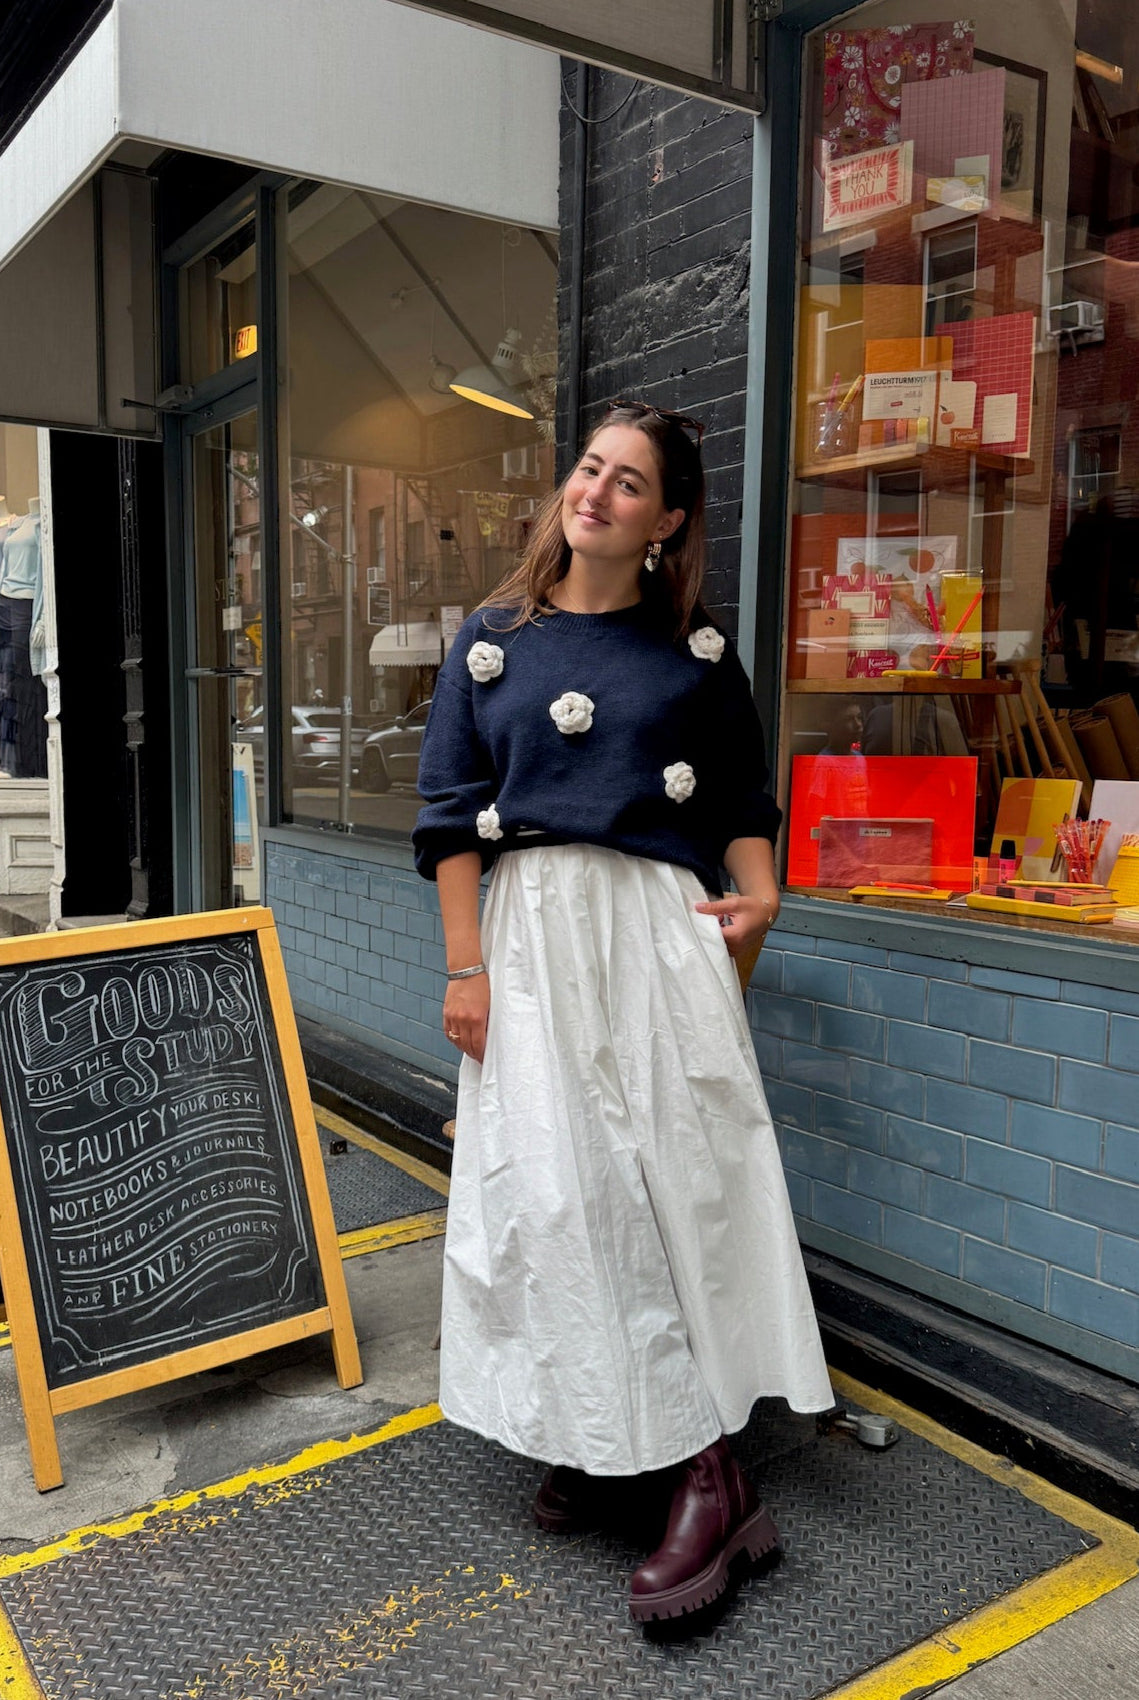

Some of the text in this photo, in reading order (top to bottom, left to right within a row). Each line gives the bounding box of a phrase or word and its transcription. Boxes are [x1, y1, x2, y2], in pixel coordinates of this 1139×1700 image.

[846, 166, 883, 187] THANK
[850, 182, 874, 200] YOU
[236, 327, 251, 353] EXIT
[10, 961, 251, 1077] GOODS
[25, 1051, 114, 1100] FOR THE
[114, 1021, 257, 1106] STUDY
[39, 1091, 261, 1182] BEAUTIFY YOUR DESK!
[49, 1135, 266, 1224] NOTEBOOKS & JOURNALS
[57, 1177, 277, 1266] LEATHER DESK ACCESSORIES
[63, 1220, 279, 1308] AND FINE STATIONERY
